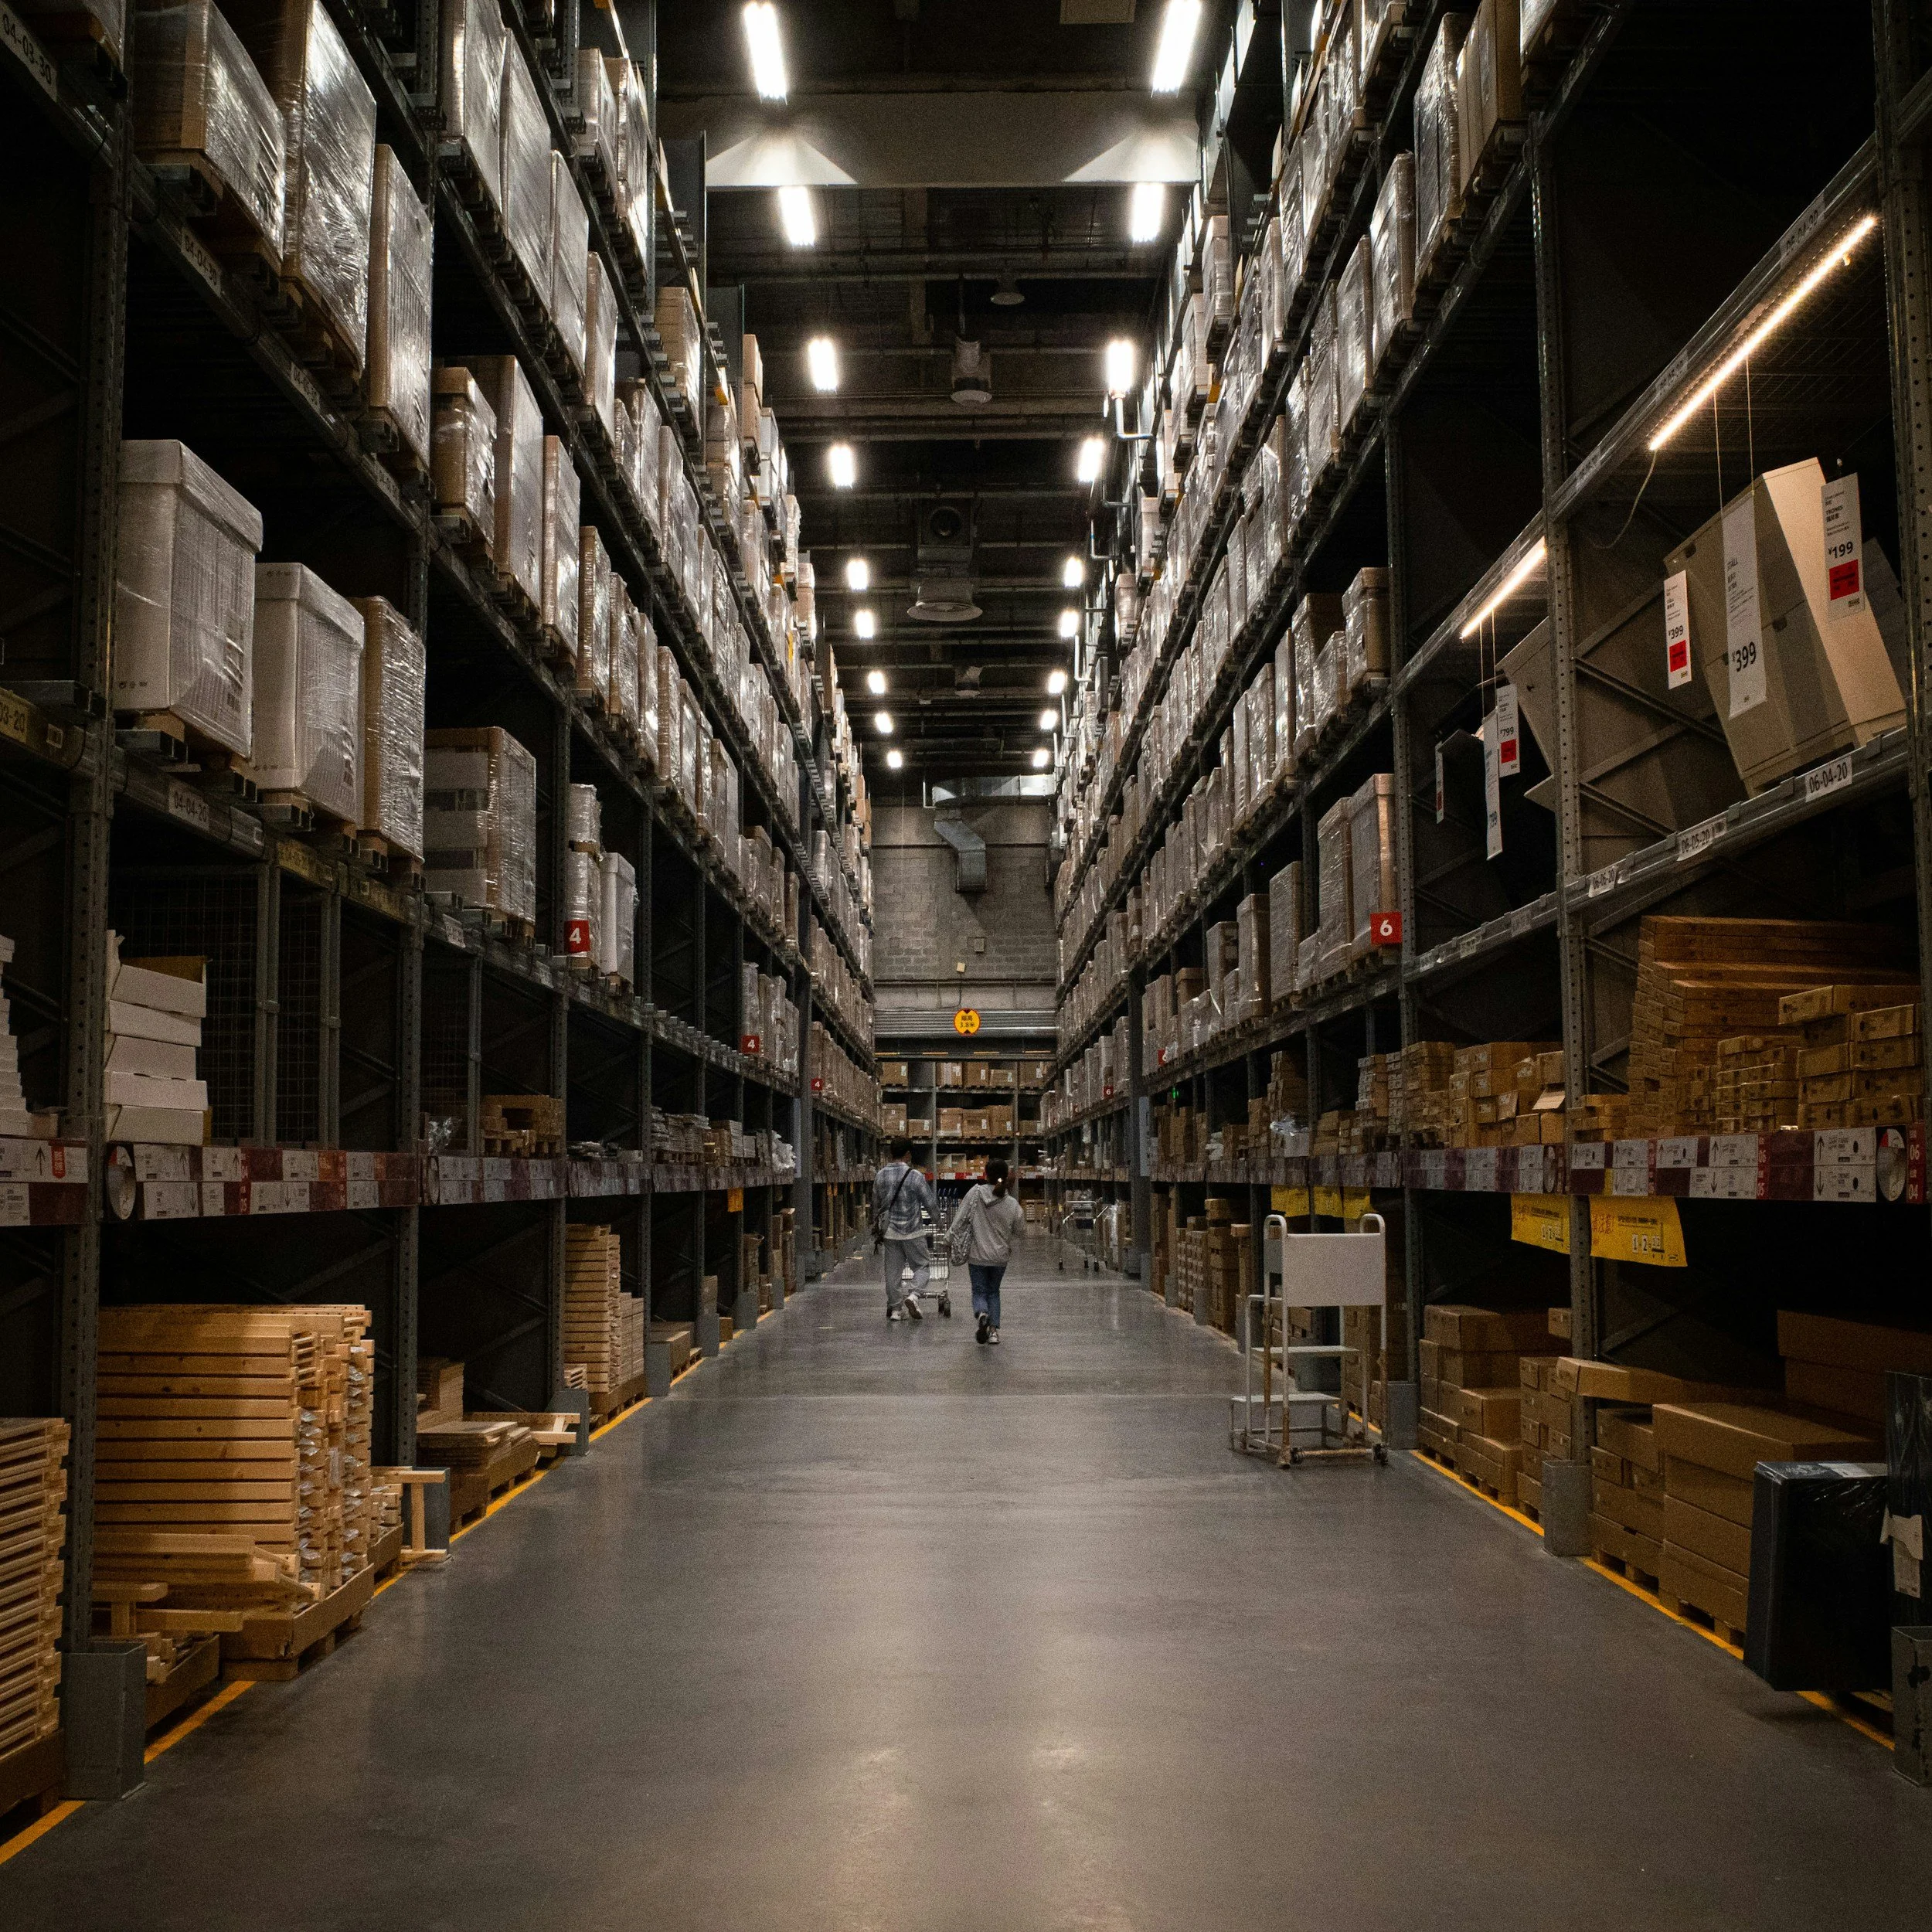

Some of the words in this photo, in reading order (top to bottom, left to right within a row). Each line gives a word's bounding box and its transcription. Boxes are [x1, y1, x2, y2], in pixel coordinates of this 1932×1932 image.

[2, 13, 52, 86] 04-03-30
[1828, 541, 1854, 559] ¥199
[1668, 624, 1684, 640] ¥399
[1732, 641, 1757, 672] ¥399
[1809, 761, 1849, 794] 06-04-20
[174, 791, 208, 823] 04-04-20
[1681, 828, 1710, 854] 06-05-20
[569, 927, 582, 944] 4
[1379, 919, 1393, 937] 6
[747, 1039, 756, 1049] 4
[1910, 1144, 1920, 1161] 06
[1909, 1183, 1919, 1200] 04
